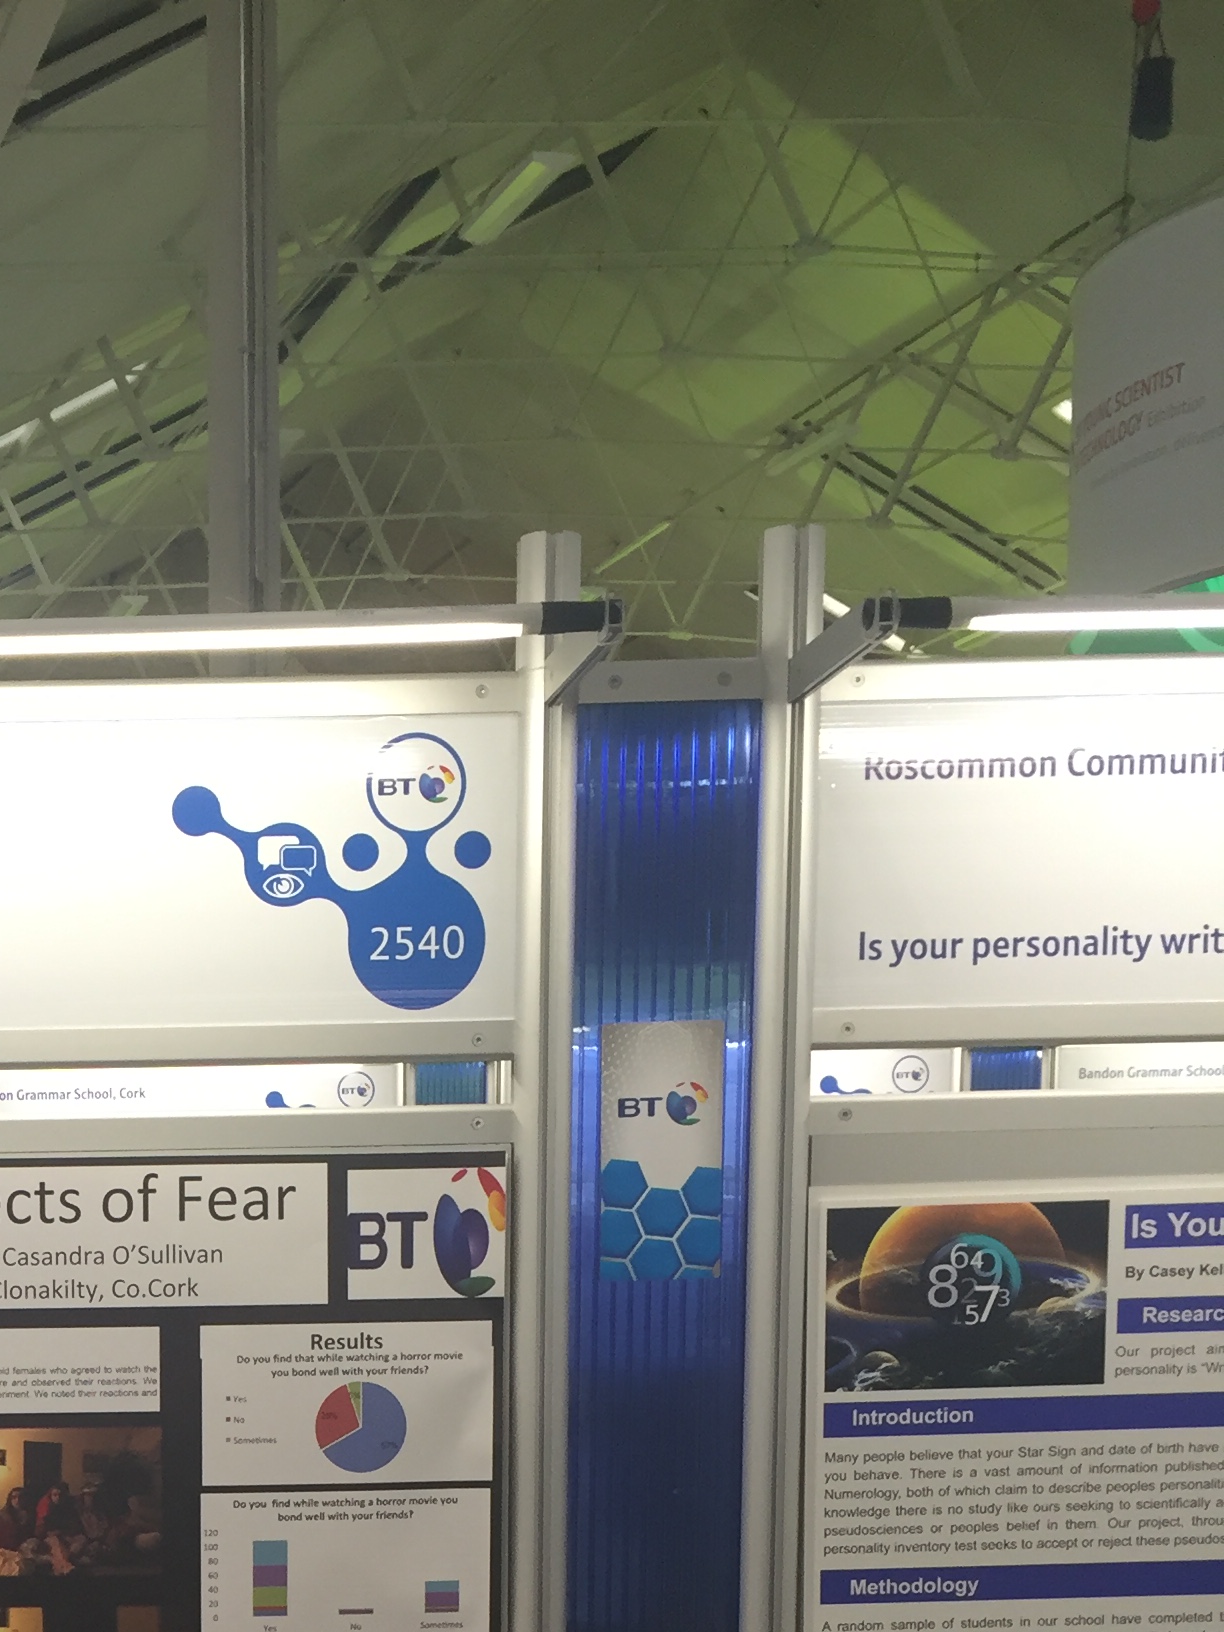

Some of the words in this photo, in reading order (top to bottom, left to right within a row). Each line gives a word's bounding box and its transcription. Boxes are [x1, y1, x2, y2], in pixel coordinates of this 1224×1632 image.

[1114, 362, 1185, 413] SCIENTIST
[864, 756, 1056, 781] Roscommon
[377, 778, 416, 796] BT
[369, 924, 464, 960] 2540
[859, 931, 882, 960] Is
[888, 937, 964, 967] your
[972, 925, 1152, 966] personality
[1160, 923, 1224, 954] writ
[1078, 1066, 1124, 1080] Bandon
[1126, 1066, 1183, 1078] Grammar
[16, 1088, 71, 1100] Grammar
[73, 1087, 116, 1100] School,
[119, 1087, 145, 1098] Cork
[618, 1098, 662, 1117] BT
[102, 1172, 158, 1223] of
[178, 1175, 296, 1221] Fear
[1131, 1213, 1157, 1239] Is
[1167, 1211, 1224, 1237] You
[348, 1212, 428, 1270] BT
[2, 1245, 104, 1266] Casandra
[112, 1243, 222, 1265] O'Sullivan
[1125, 1265, 1145, 1281] By
[1148, 1264, 1195, 1280] Casey
[111, 1276, 198, 1298] Co.Cork
[1142, 1306, 1224, 1323] Researc
[310, 1331, 383, 1350] Results
[236, 1354, 250, 1364] Do
[252, 1356, 271, 1365] you
[272, 1353, 292, 1363] find
[294, 1353, 314, 1362] that
[316, 1353, 343, 1362] while
[345, 1352, 390, 1363] watching
[391, 1353, 398, 1361] a
[400, 1351, 432, 1360] horror
[433, 1352, 463, 1360] movie
[270, 1369, 289, 1378] you
[291, 1367, 316, 1376] bond
[318, 1366, 339, 1376] well
[341, 1366, 363, 1375] with
[365, 1368, 388, 1377] your
[389, 1364, 429, 1374] friends?
[852, 1406, 973, 1426] Introduction
[824, 1451, 859, 1465] Many
[863, 1450, 905, 1464] people
[909, 1449, 954, 1461] believe
[957, 1448, 982, 1460] that
[986, 1449, 1014, 1461] your
[1017, 1446, 1044, 1458] Star
[1047, 1445, 1076, 1459] Sign
[1080, 1444, 1104, 1456] and
[1107, 1444, 1136, 1455] date
[1139, 1442, 1153, 1454] of
[1156, 1442, 1184, 1454] birth
[1188, 1442, 1219, 1453] have
[850, 1576, 979, 1596] Methodology
